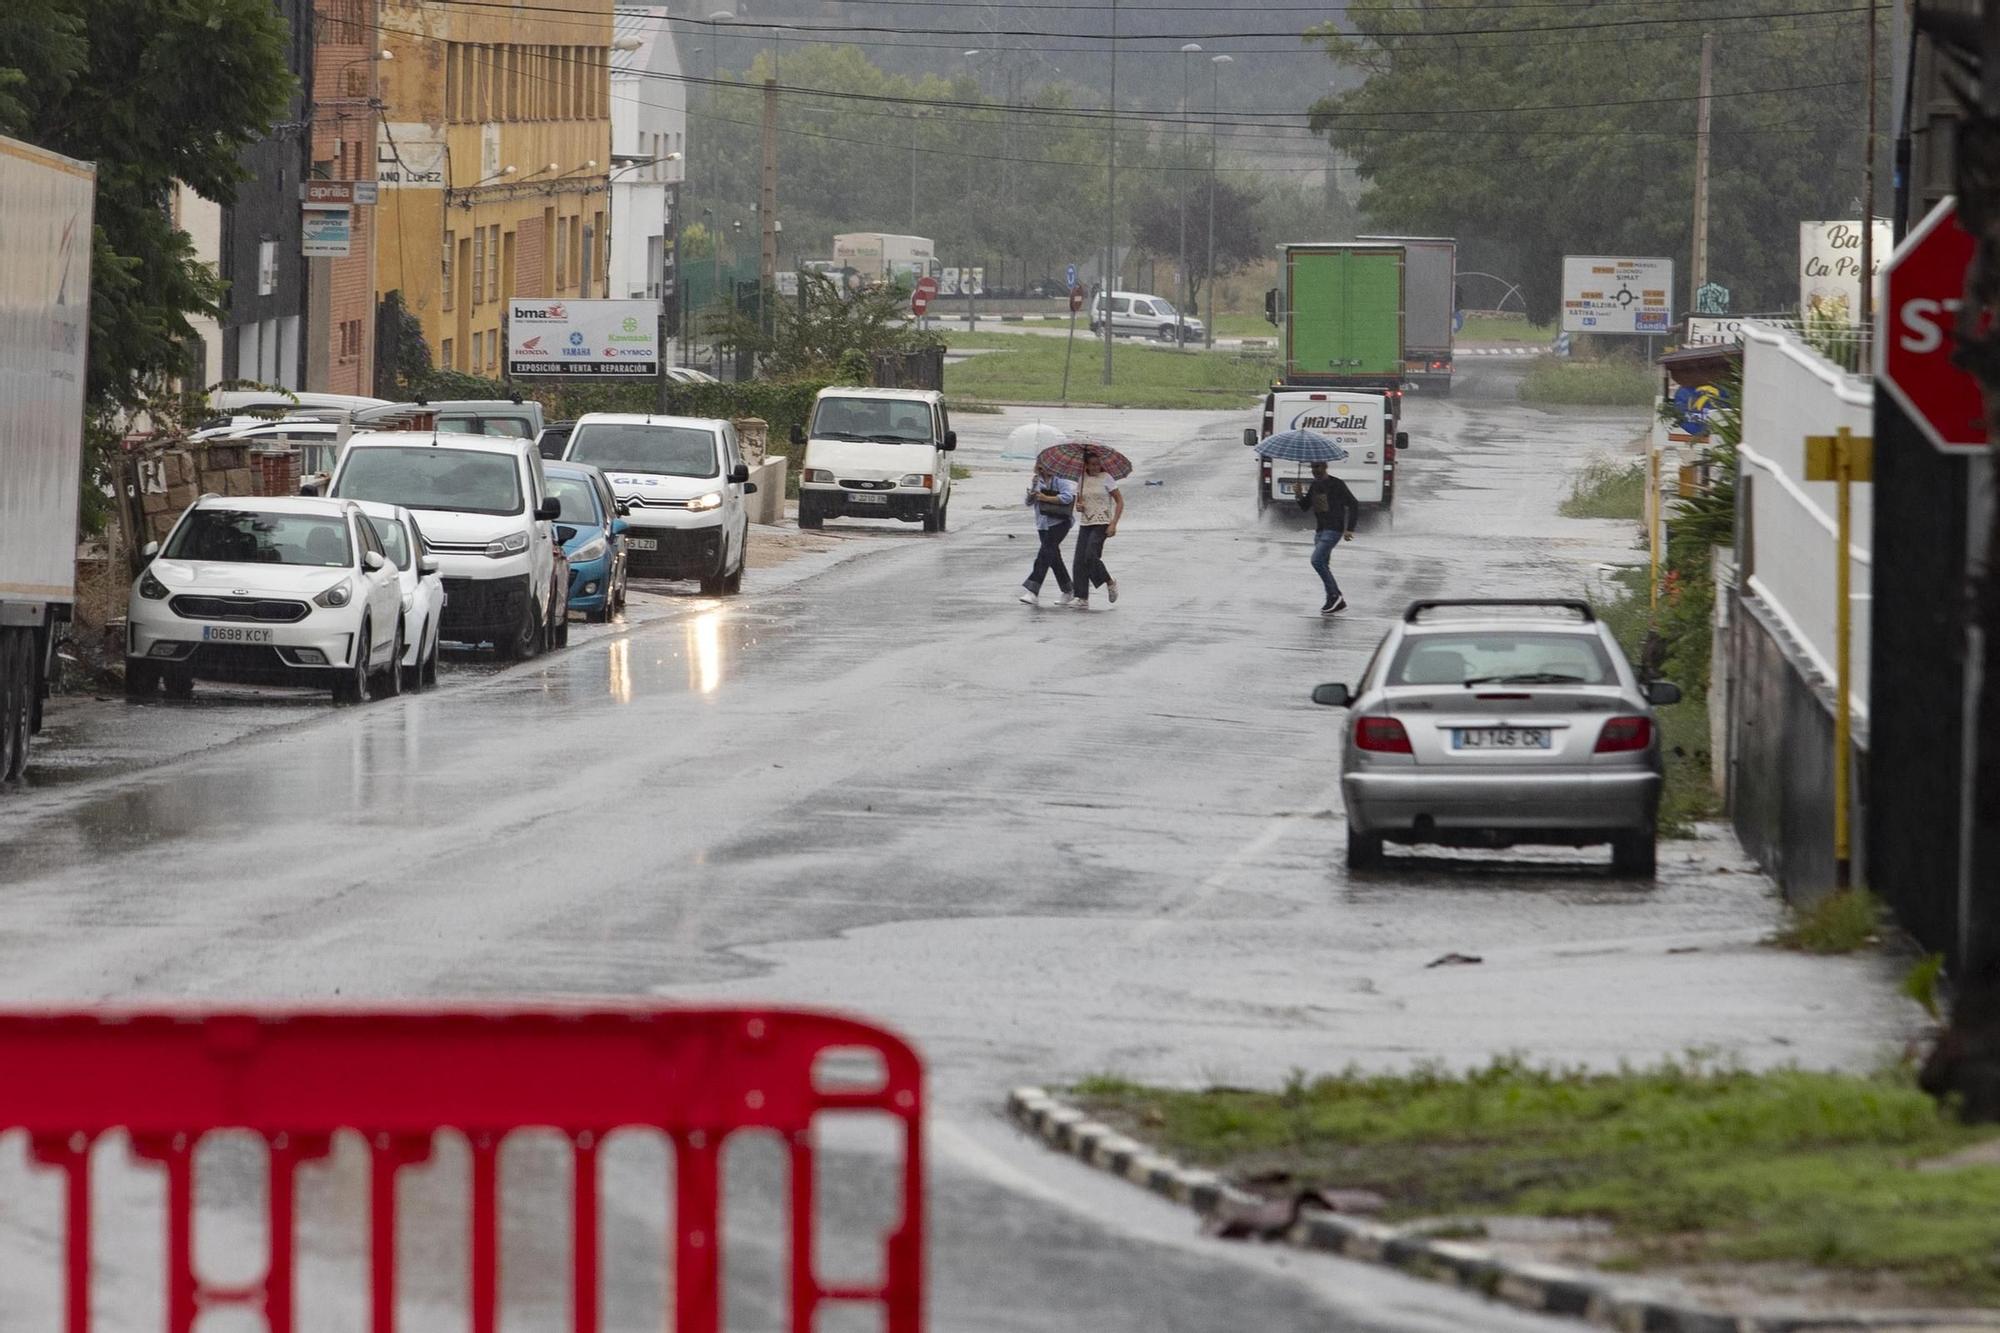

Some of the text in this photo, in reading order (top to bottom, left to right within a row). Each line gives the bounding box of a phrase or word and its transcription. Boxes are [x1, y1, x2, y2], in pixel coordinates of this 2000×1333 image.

[310, 184, 350, 199] aprilia
[1827, 224, 1866, 250] Ba
[1805, 256, 1881, 284] Ca Pei
[515, 307, 547, 319] bma
[608, 333, 652, 342] Kawasaki
[562, 348, 592, 356] YAMAHA
[569, 364, 593, 373] VENTA
[600, 364, 648, 373] REPARACIÓN
[1302, 415, 1368, 430] marsatel
[614, 478, 659, 486] GLS
[211, 628, 269, 641] 0698 KCY
